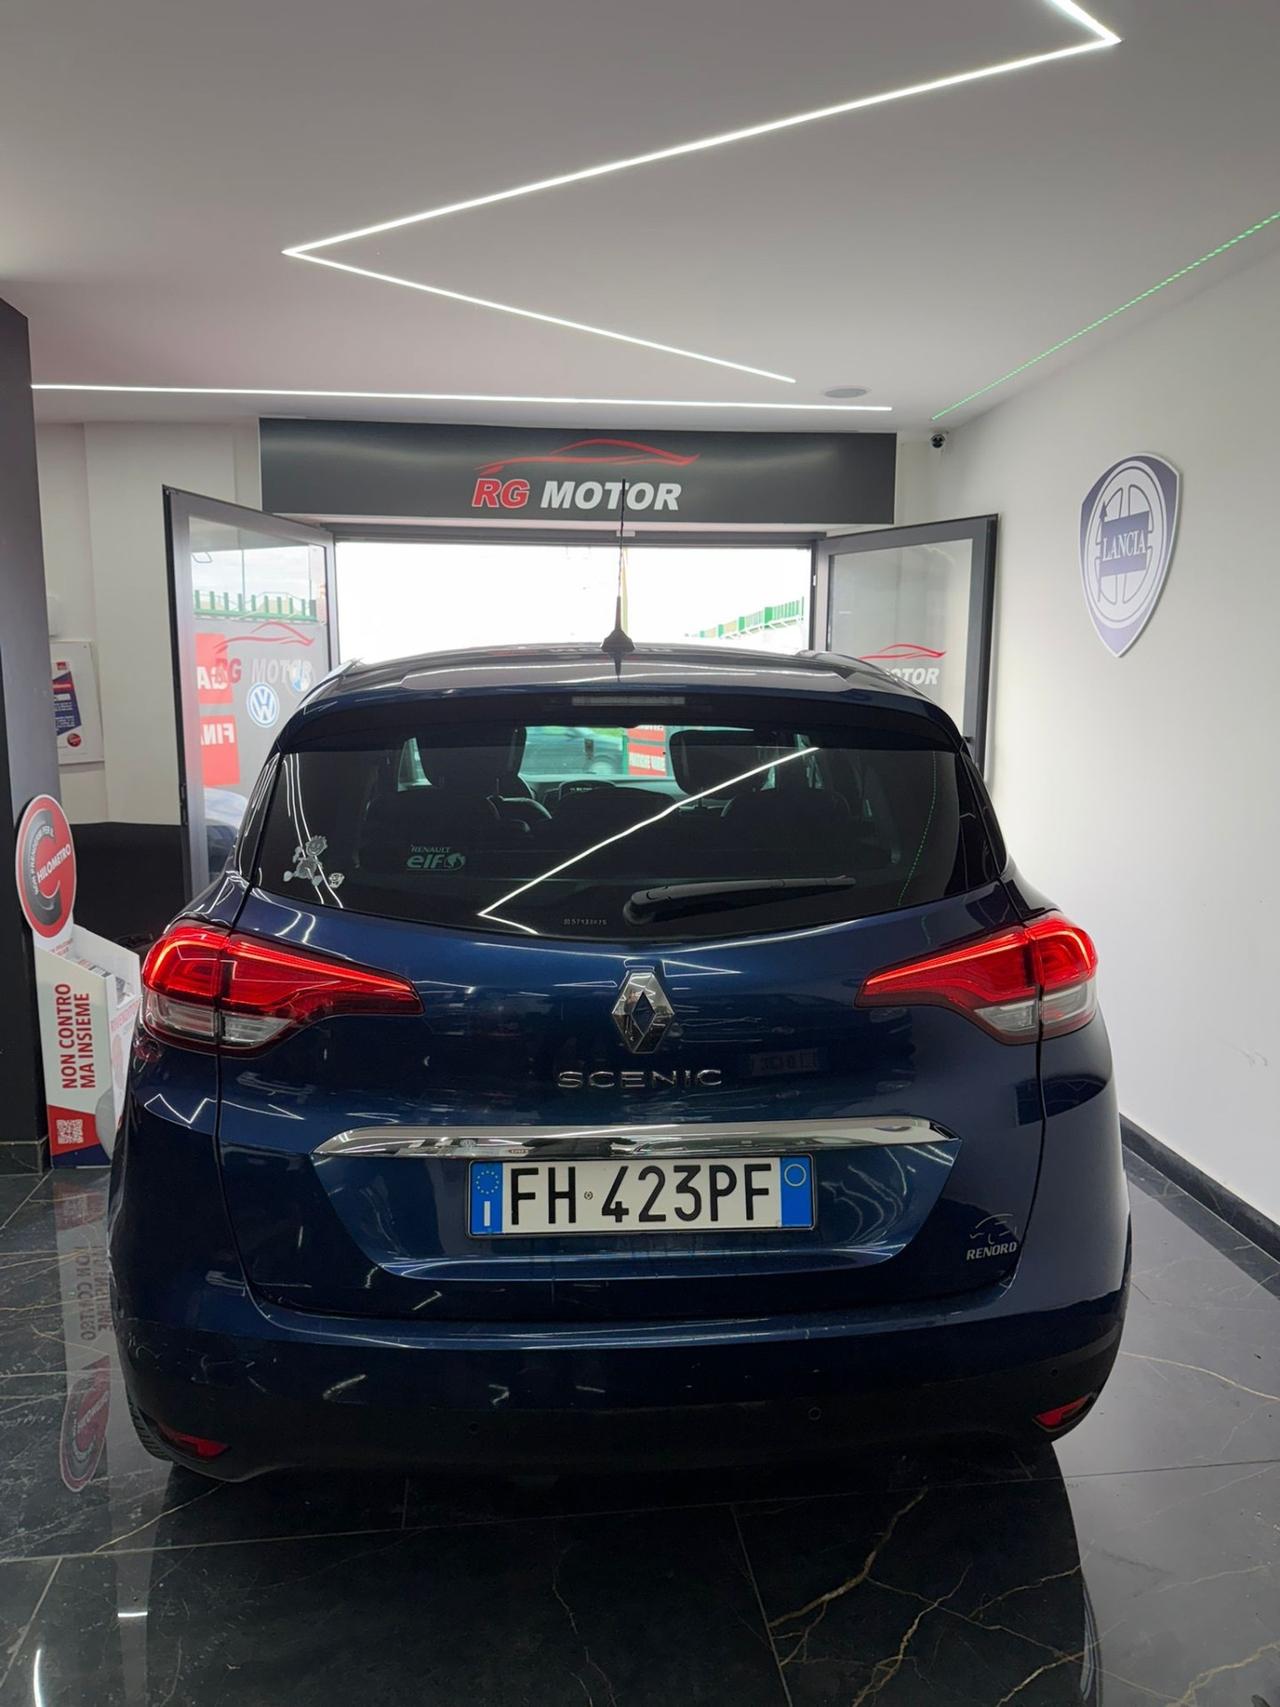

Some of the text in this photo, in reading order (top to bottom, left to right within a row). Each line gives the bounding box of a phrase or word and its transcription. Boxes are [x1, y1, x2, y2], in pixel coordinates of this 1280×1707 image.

[471, 478, 682, 511] RG MOTOR
[1102, 529, 1147, 561] LANCIA
[884, 667, 940, 686] OTOR
[55, 983, 78, 1090] NON CONTRO
[74, 992, 96, 1089] MA INSIEME
[556, 1069, 723, 1089] SCENIC
[966, 1241, 1018, 1261] RENORD
